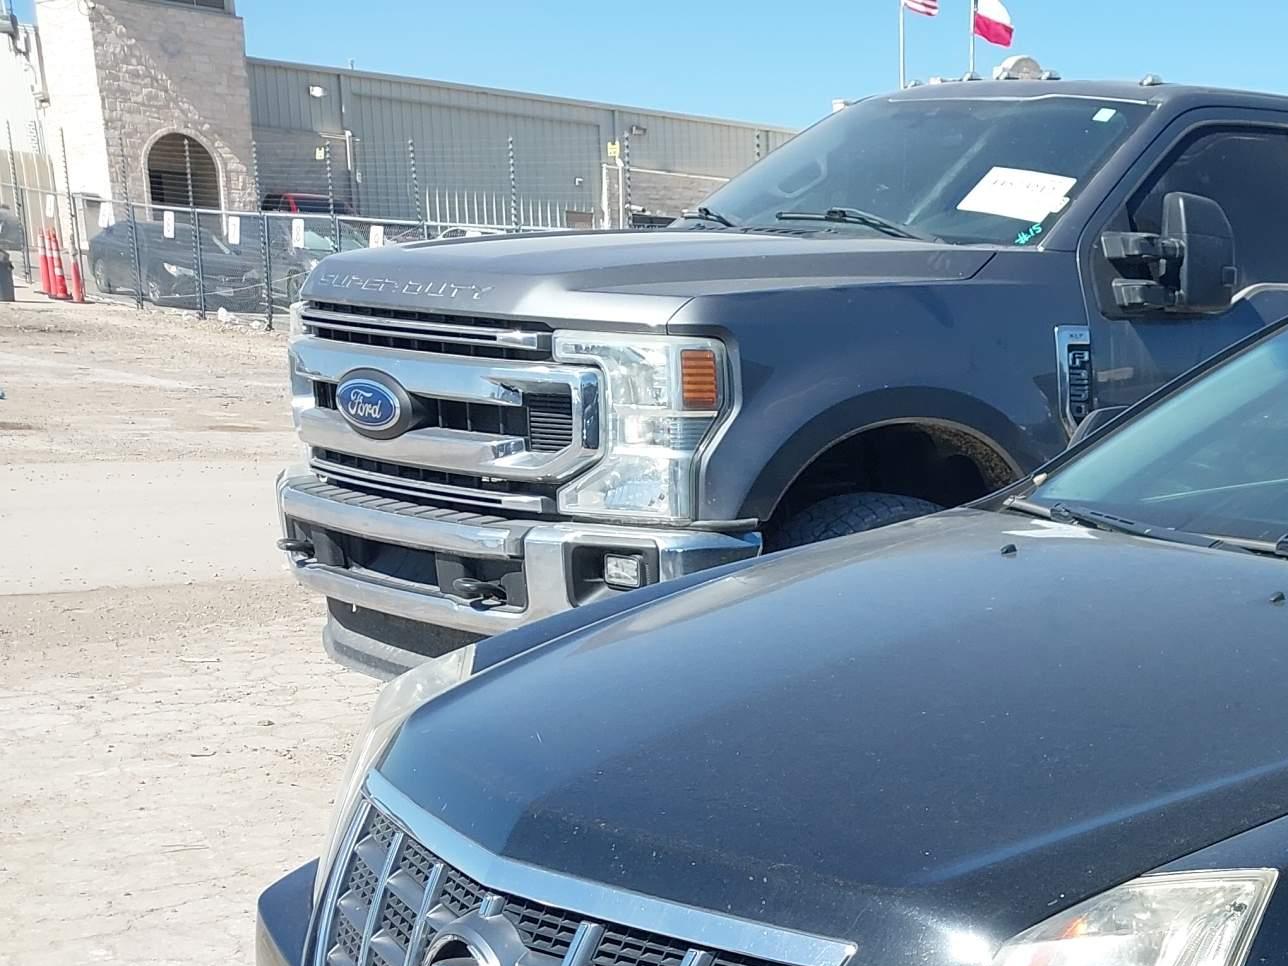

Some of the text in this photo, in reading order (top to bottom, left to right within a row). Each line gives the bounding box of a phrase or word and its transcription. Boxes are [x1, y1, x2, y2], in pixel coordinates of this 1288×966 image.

[319, 274, 496, 300] SUPER DUTY
[348, 388, 383, 419] Ford
